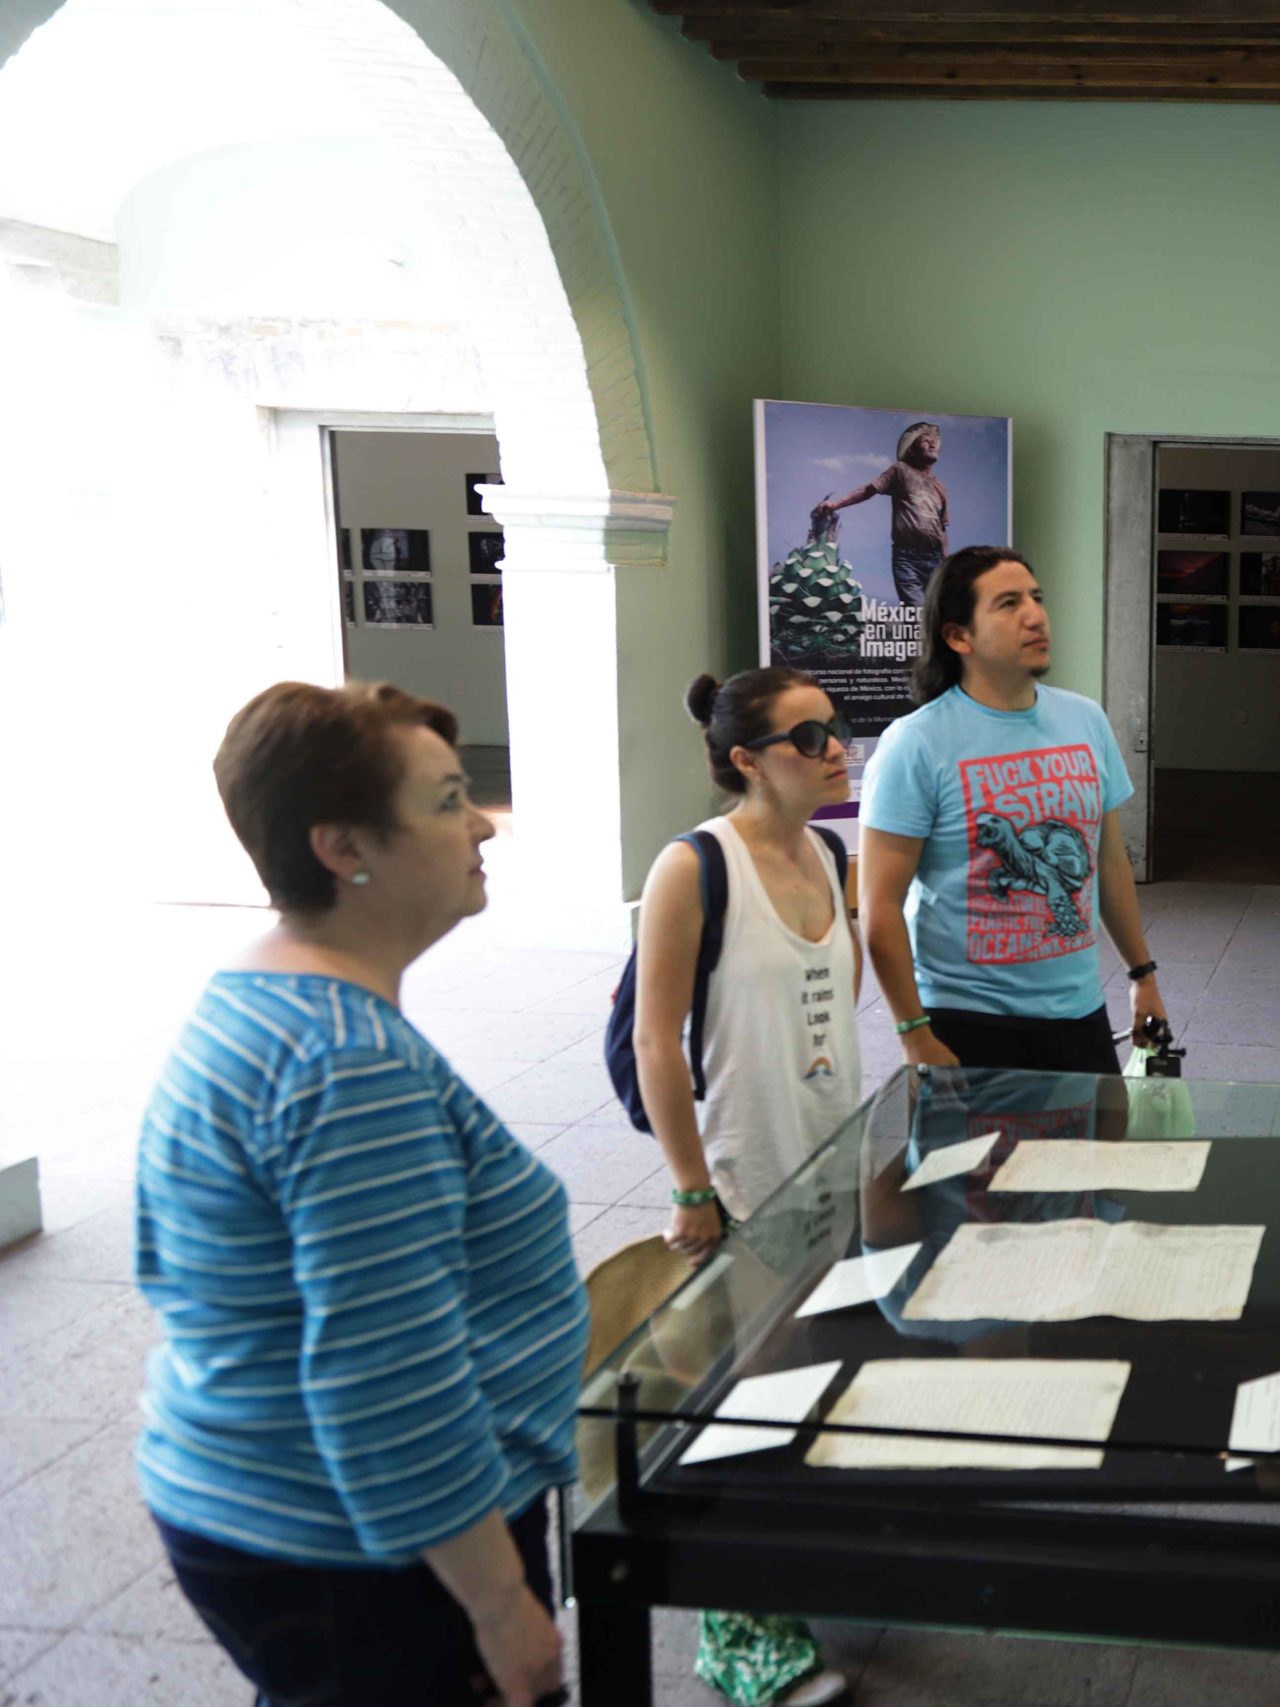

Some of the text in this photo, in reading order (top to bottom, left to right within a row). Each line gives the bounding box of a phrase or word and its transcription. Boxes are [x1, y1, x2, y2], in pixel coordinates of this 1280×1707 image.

[865, 622, 923, 640] en una
[965, 750, 1094, 809] FUCK YOUR
[994, 779, 1099, 829] STRAW
